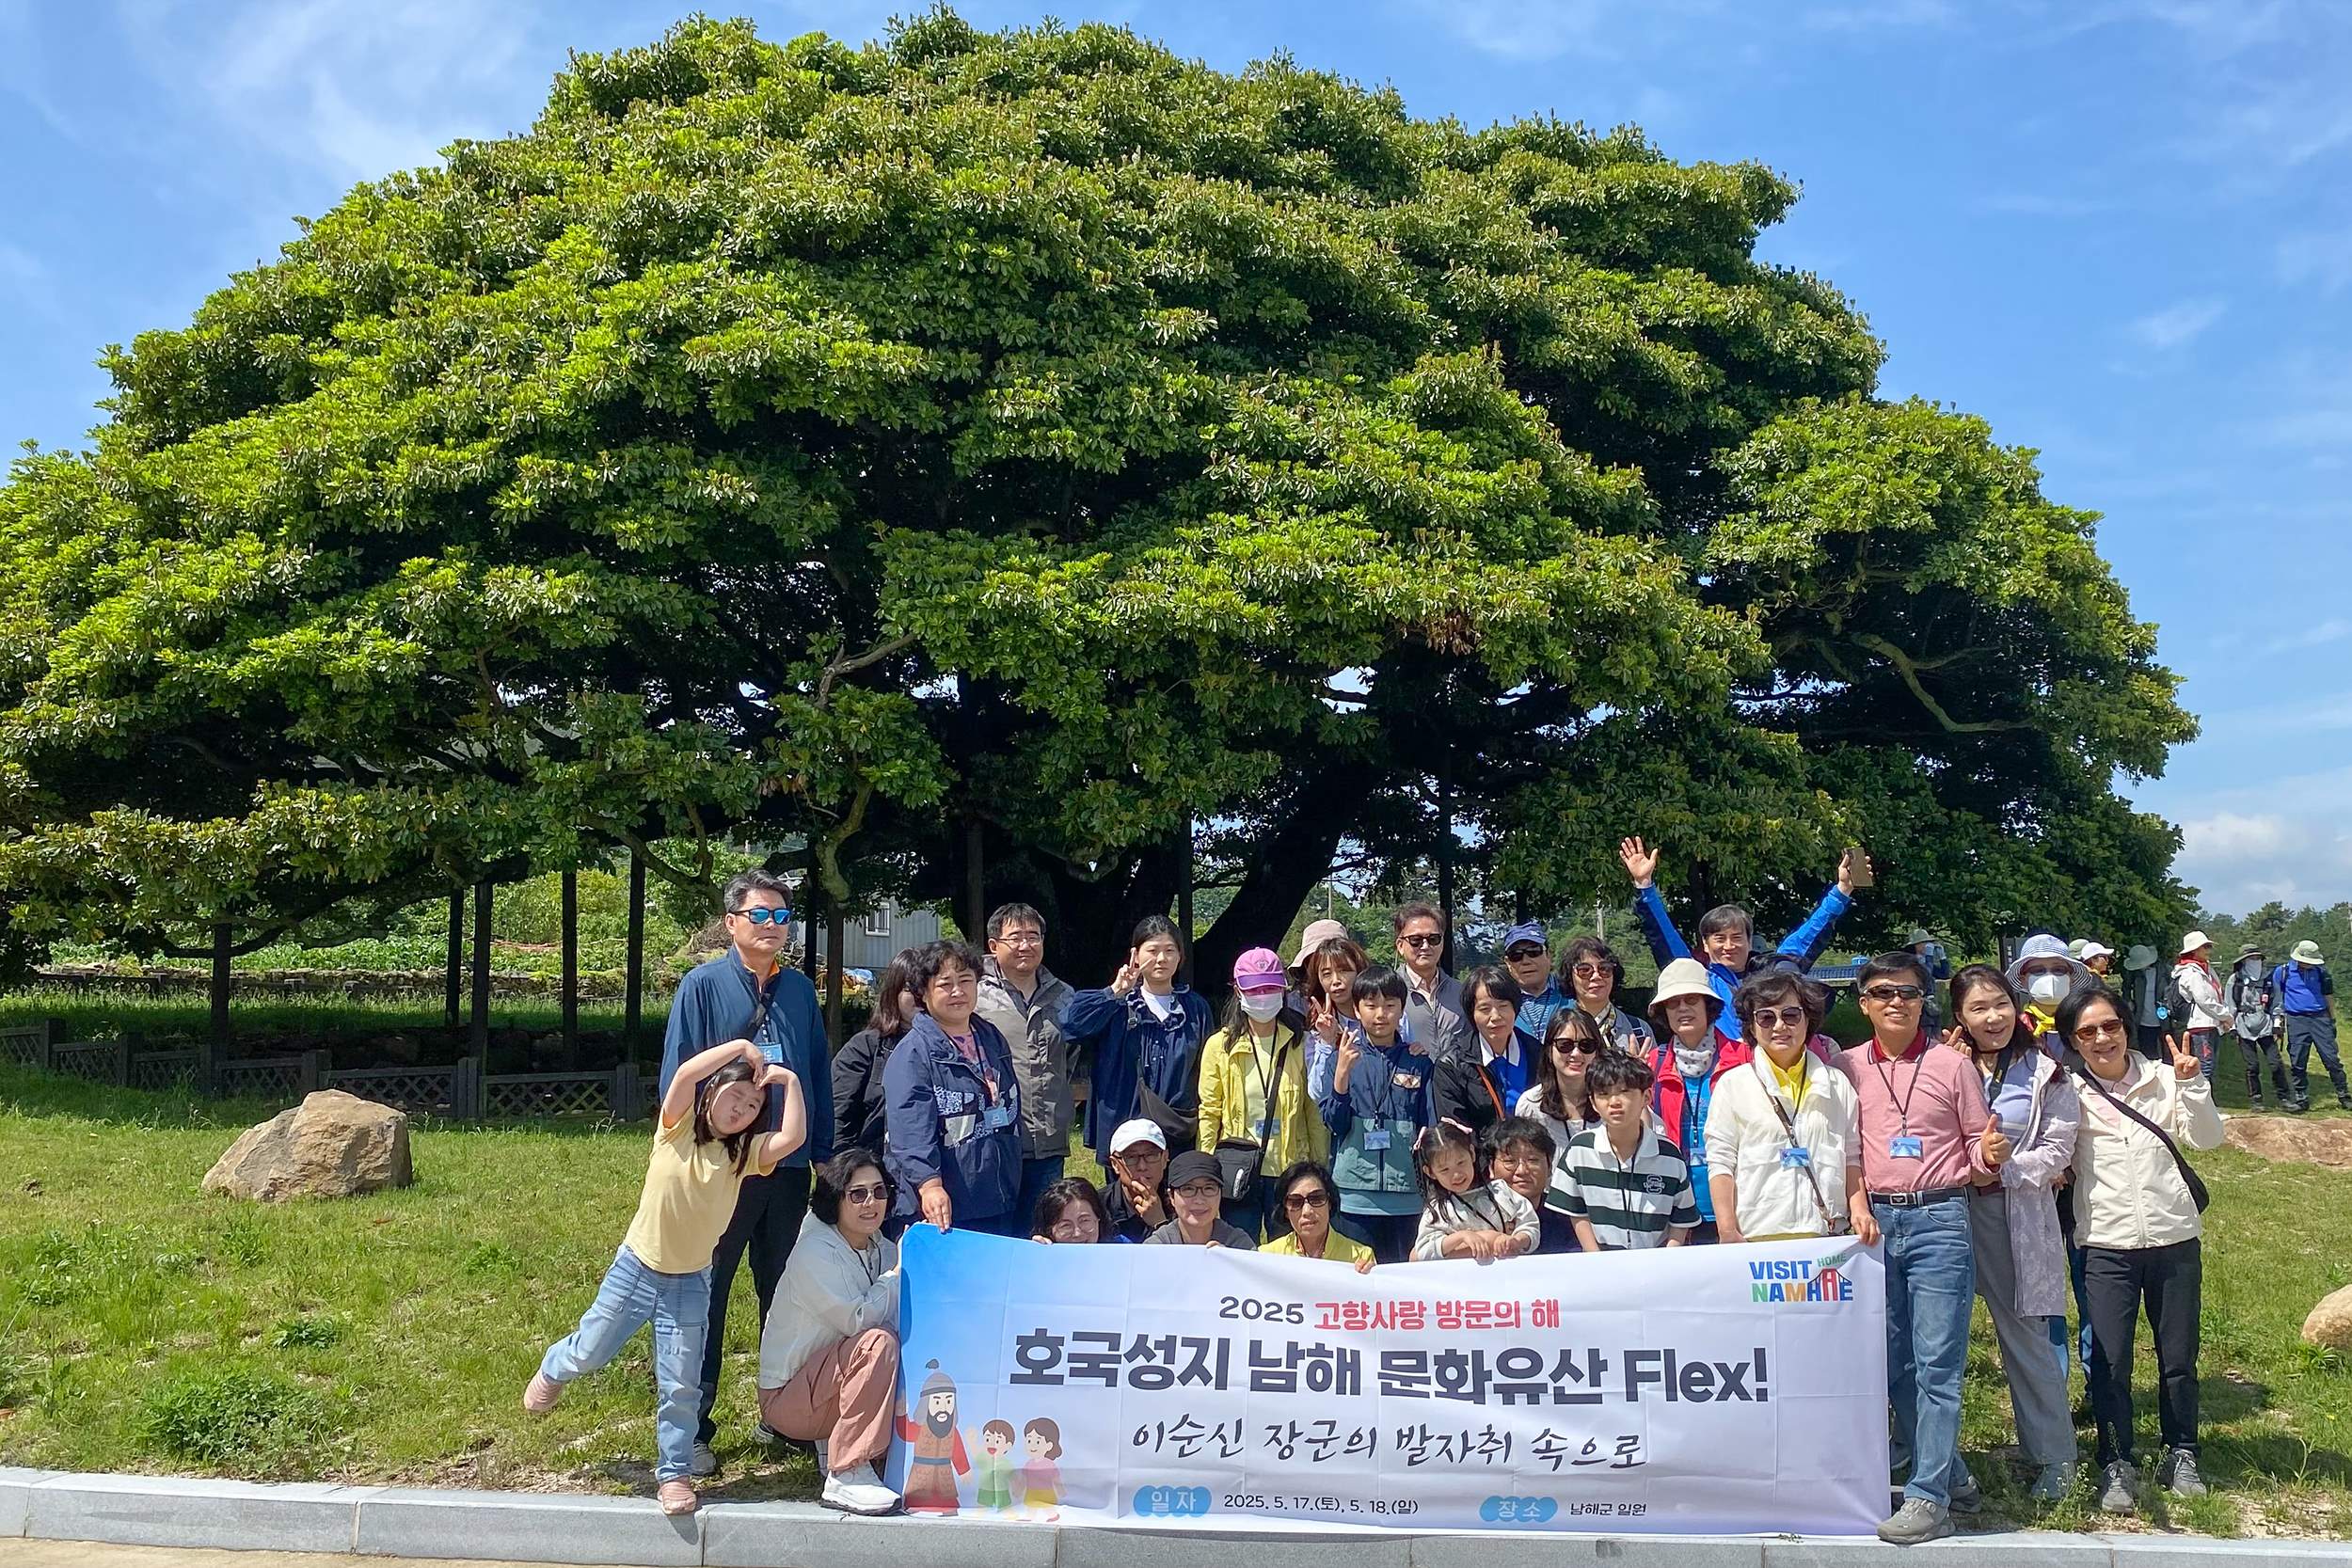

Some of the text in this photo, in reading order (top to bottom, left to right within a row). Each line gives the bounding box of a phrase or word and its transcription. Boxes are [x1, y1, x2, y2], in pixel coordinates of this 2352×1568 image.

[1749, 1253, 1848, 1280] VISIT HOME
[1752, 1268, 1853, 1302] NAMHAE
[1219, 1296, 1560, 1331] 2025 고향사랑 방문의 해
[1009, 1327, 1769, 1406] 호국성지 남해 문화유산 Flex!
[1132, 1413, 1647, 1472] 이순신 장군의 발자취 속으로
[1570, 1502, 1647, 1517] 남해군 일원
